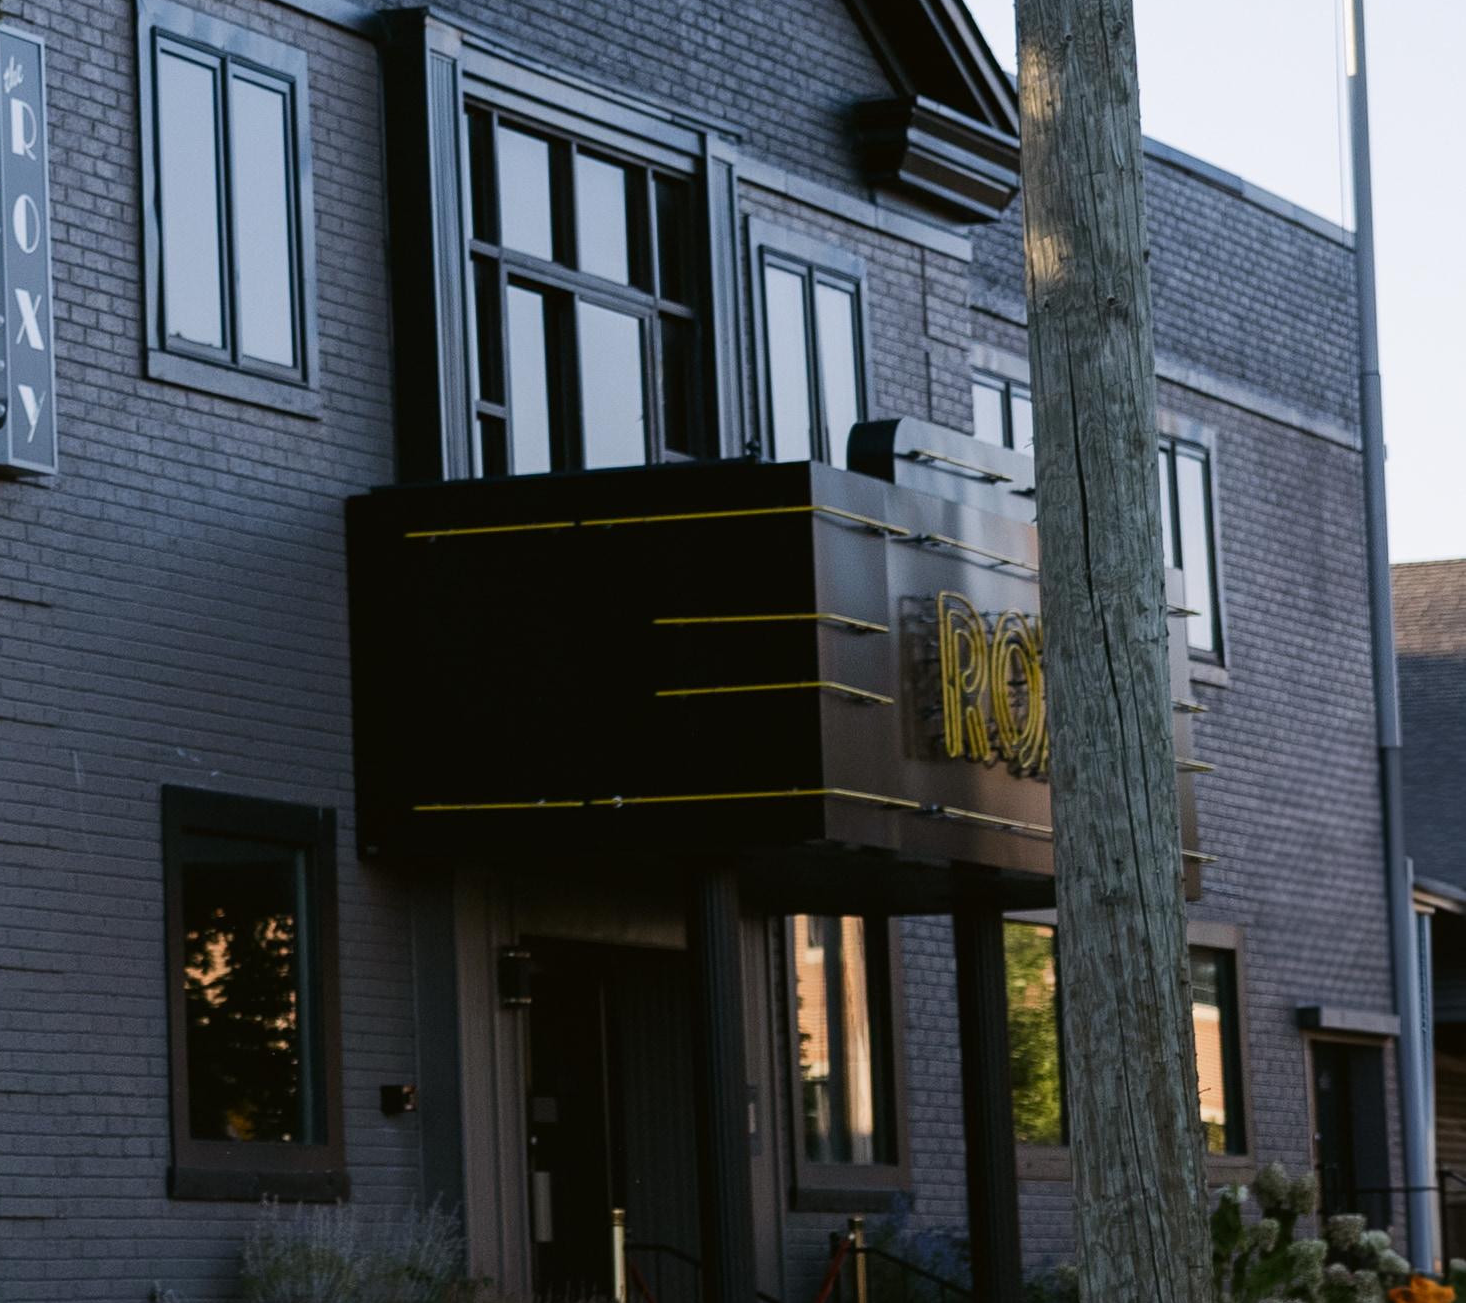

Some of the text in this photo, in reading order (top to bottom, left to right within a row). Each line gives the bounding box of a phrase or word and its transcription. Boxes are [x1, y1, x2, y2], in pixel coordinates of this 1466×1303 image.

[3, 56, 24, 94] the
[11, 98, 46, 442] ROXY
[937, 591, 1048, 772] RO
